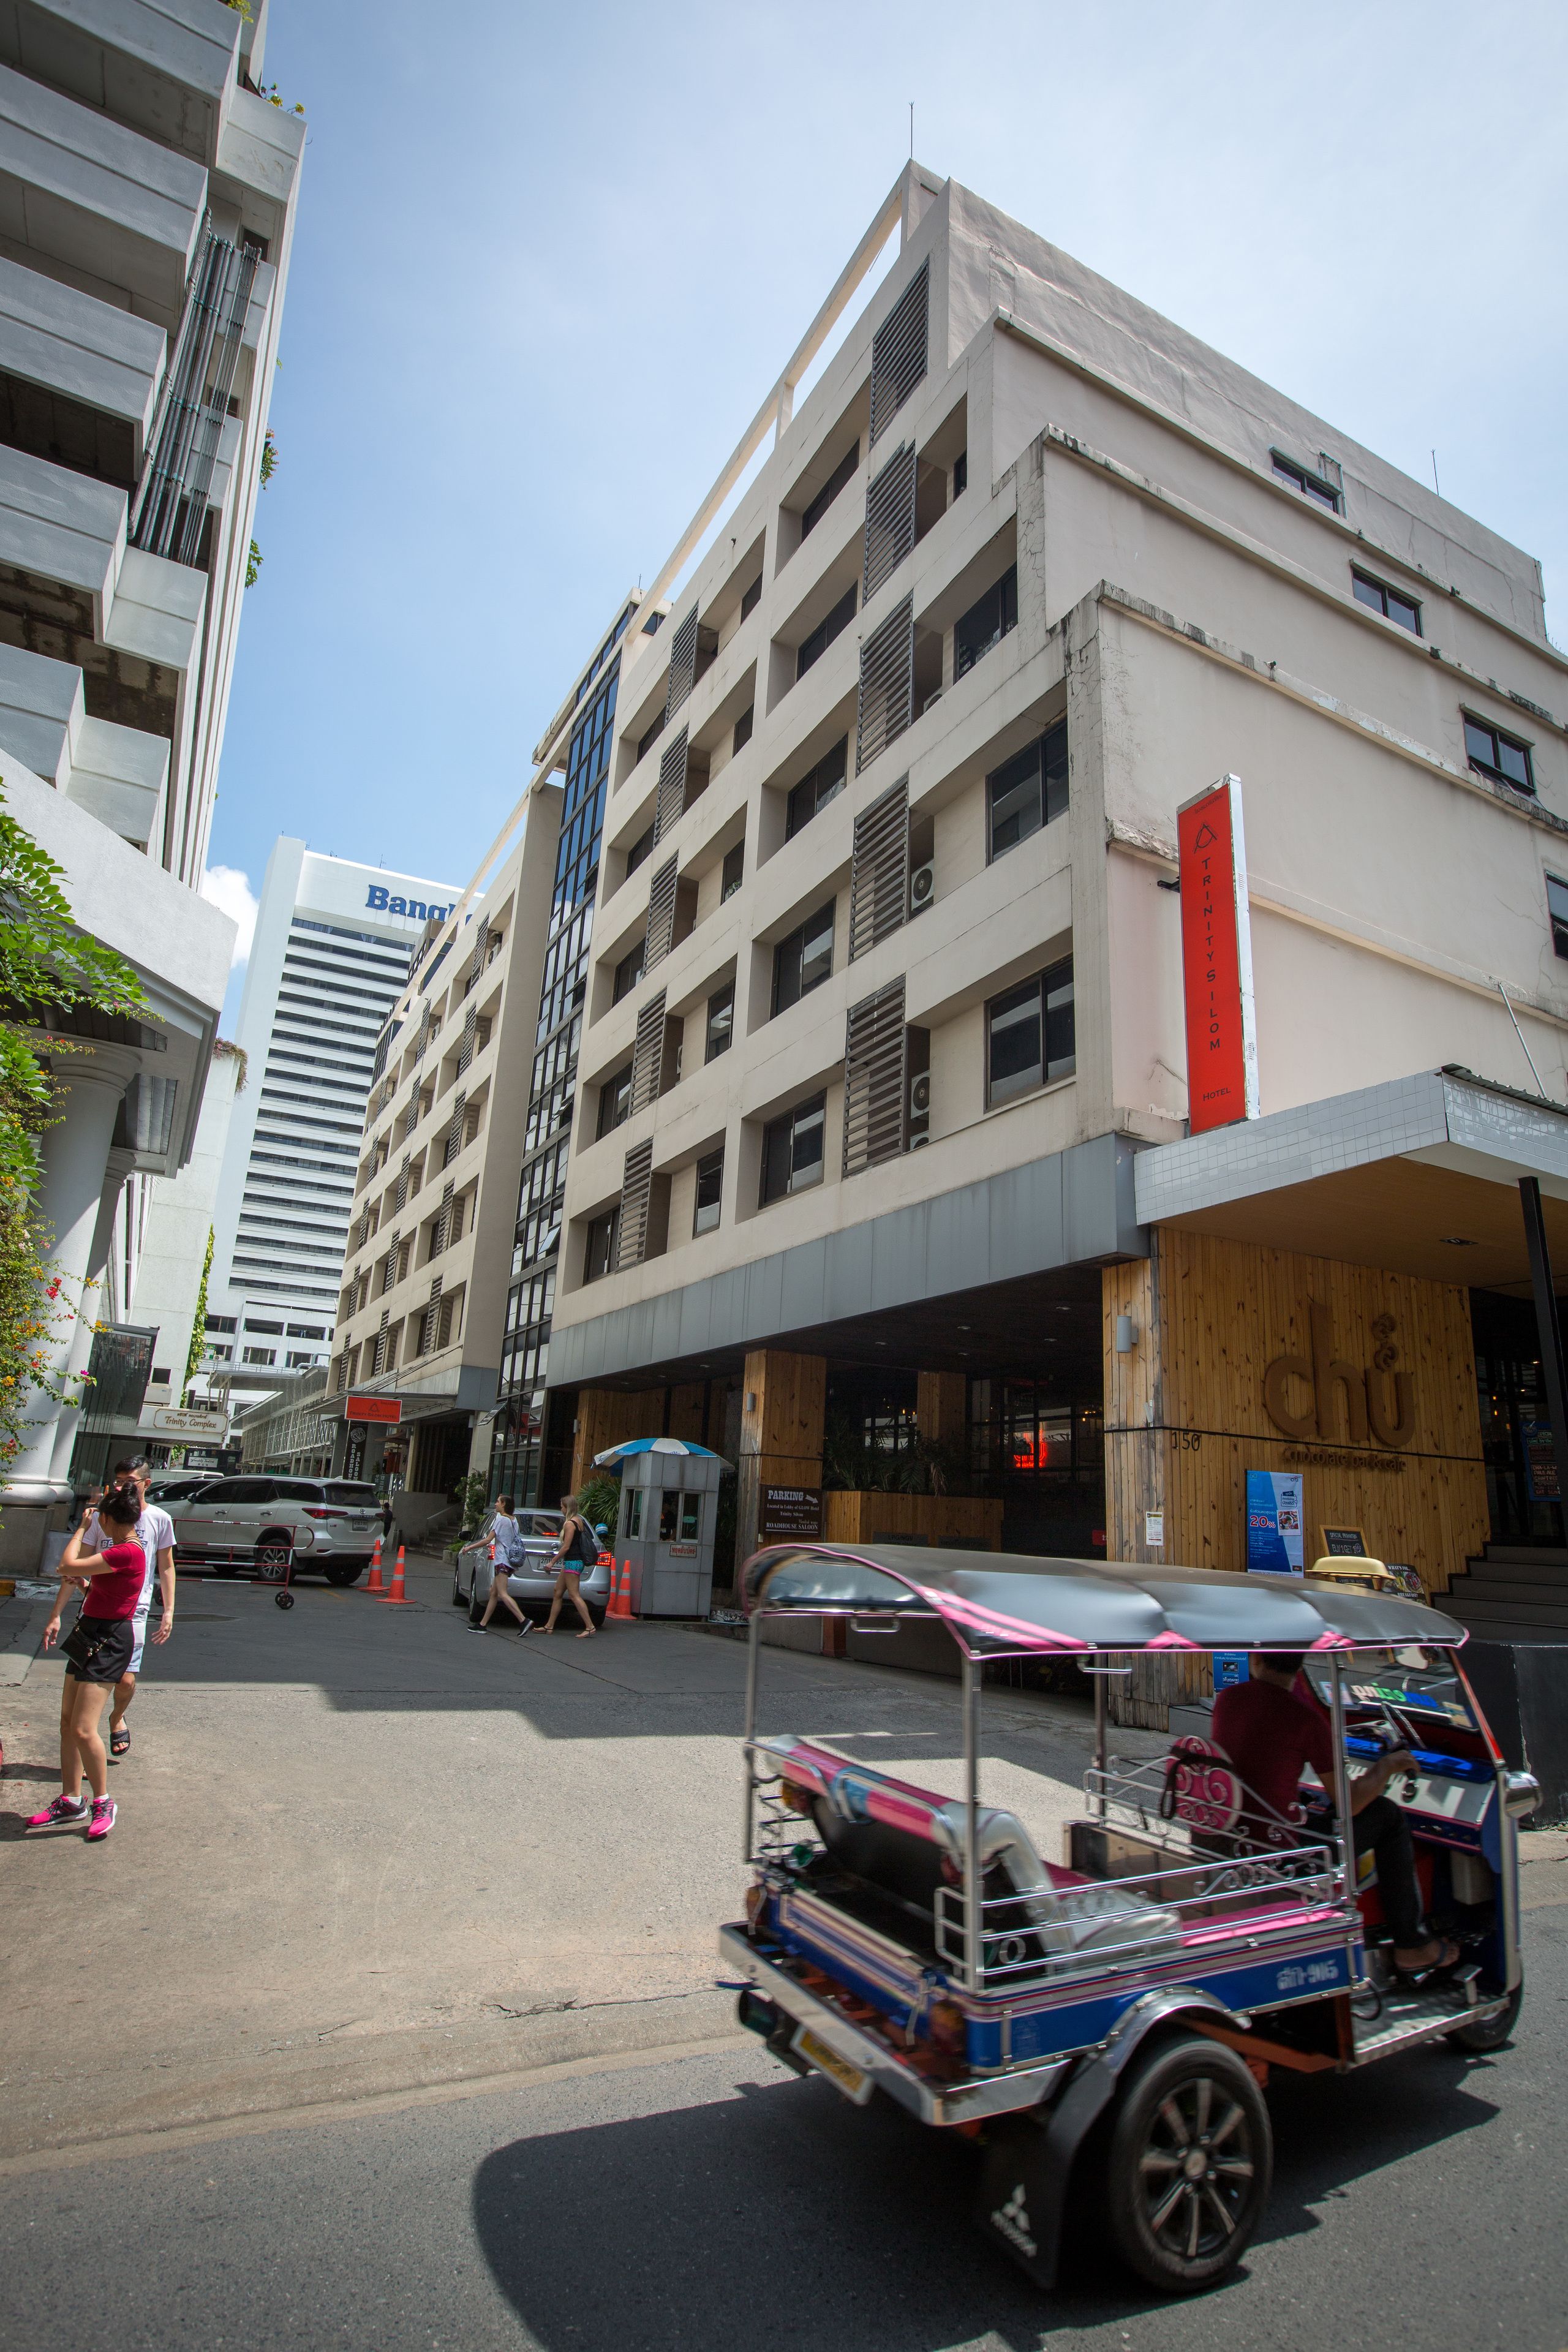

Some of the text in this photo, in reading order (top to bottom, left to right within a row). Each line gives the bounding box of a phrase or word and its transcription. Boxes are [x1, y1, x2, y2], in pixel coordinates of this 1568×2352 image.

[1202, 857, 1214, 962] TRINITY
[1207, 969, 1220, 1051] SILOM
[1203, 1087, 1232, 1102] HOTEL
[165, 1416, 217, 1430] Trinity Complex
[1172, 1431, 1200, 1451] 150
[768, 1490, 804, 1501] PARKING
[1250, 1515, 1276, 1528] 20%
